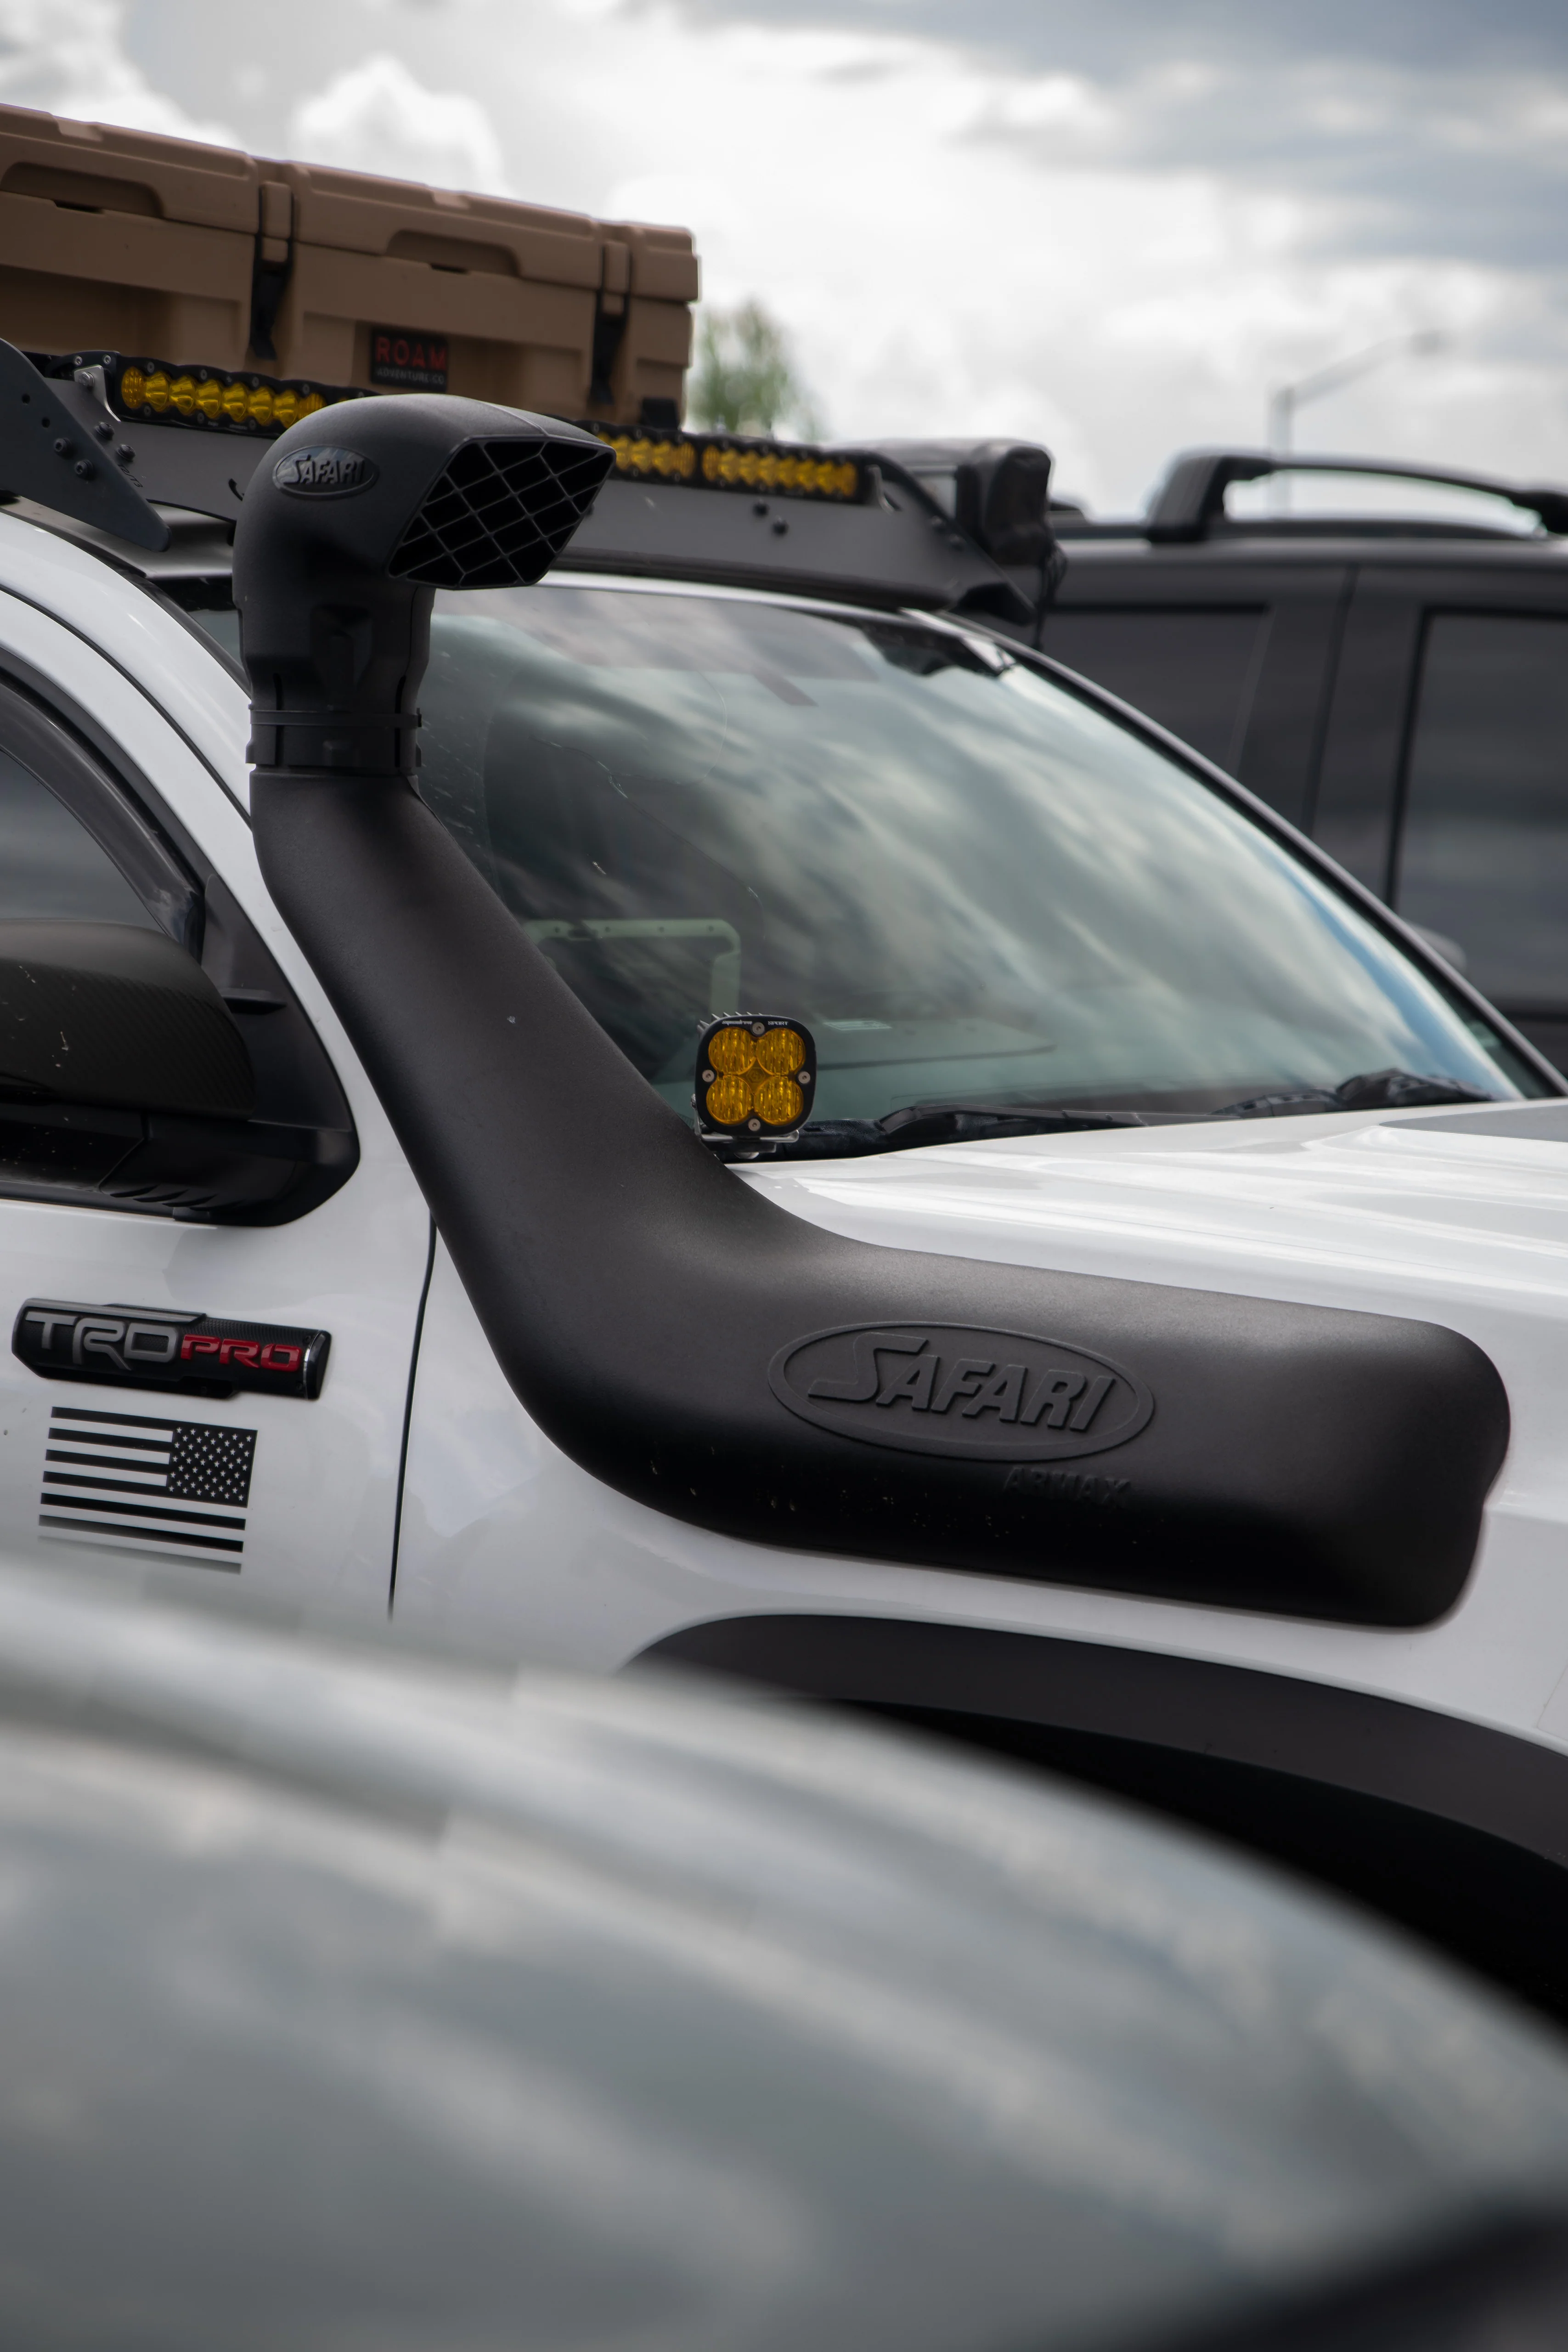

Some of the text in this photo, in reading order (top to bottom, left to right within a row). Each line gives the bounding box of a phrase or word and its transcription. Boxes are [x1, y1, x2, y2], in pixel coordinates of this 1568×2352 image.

[376, 336, 446, 370] ROAM
[377, 367, 429, 383] ADVENTURE
[283, 454, 365, 485] SAFARI
[26, 1312, 303, 1372] TRD PRO
[808, 1332, 1116, 1431] SAFARI
[1004, 1465, 1131, 1510] ARMAX
